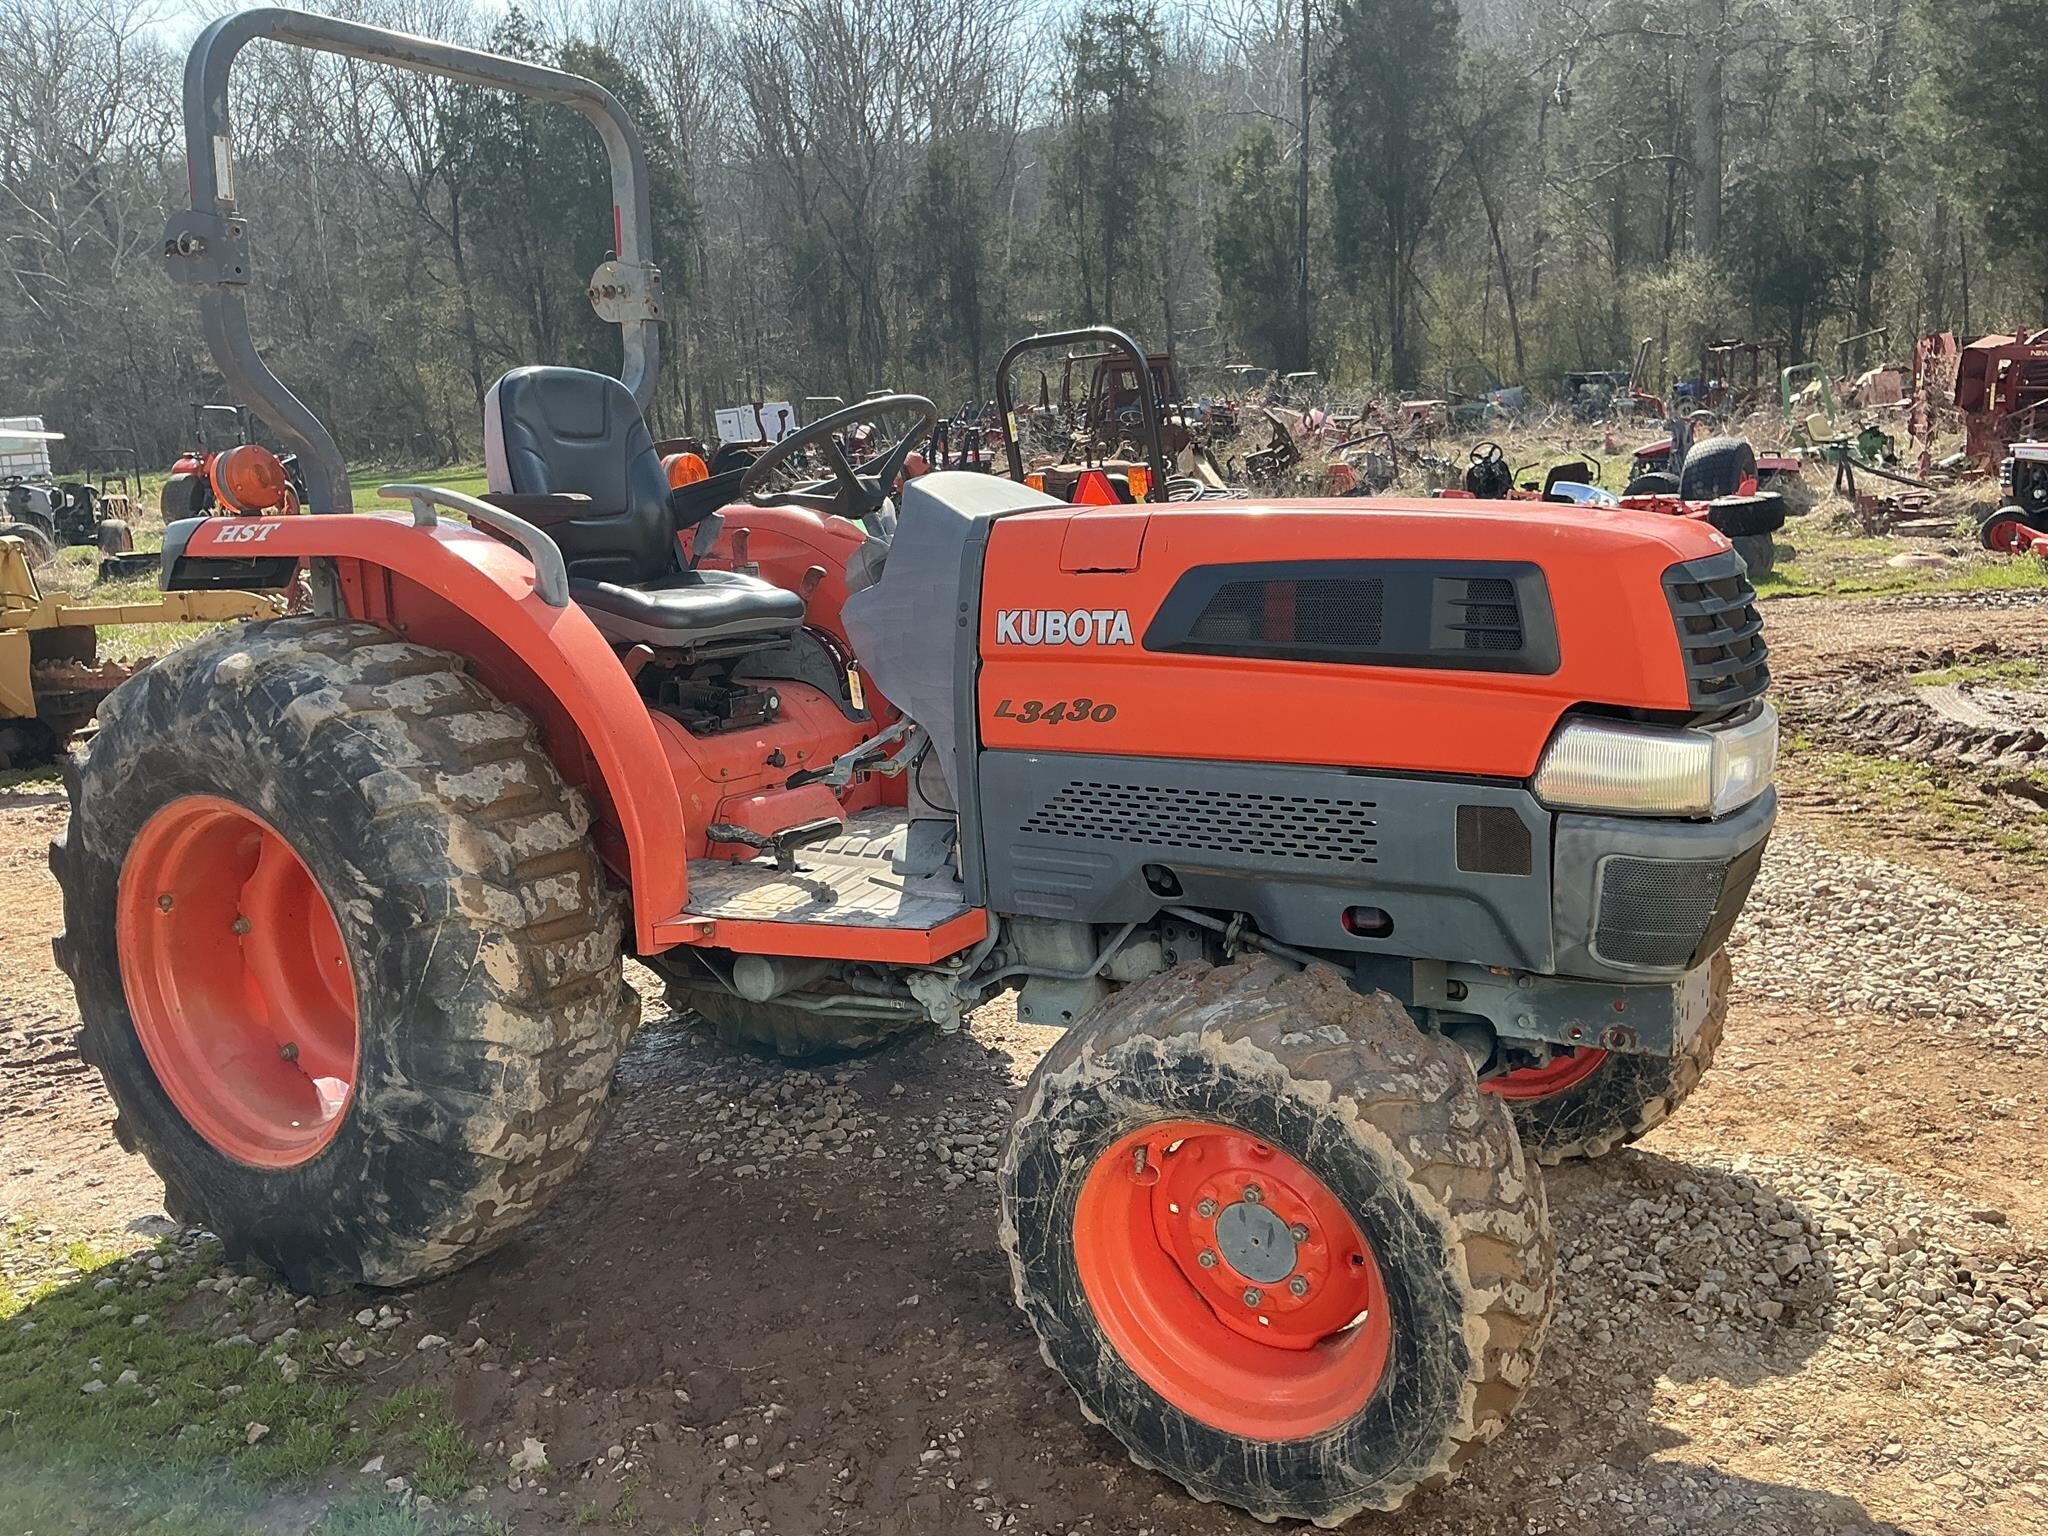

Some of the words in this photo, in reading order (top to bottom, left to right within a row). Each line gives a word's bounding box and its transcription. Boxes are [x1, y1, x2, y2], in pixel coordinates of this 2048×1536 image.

[212, 523, 282, 543] HST
[996, 608, 1135, 646] KUBOTA
[994, 698, 1118, 725] L3430
